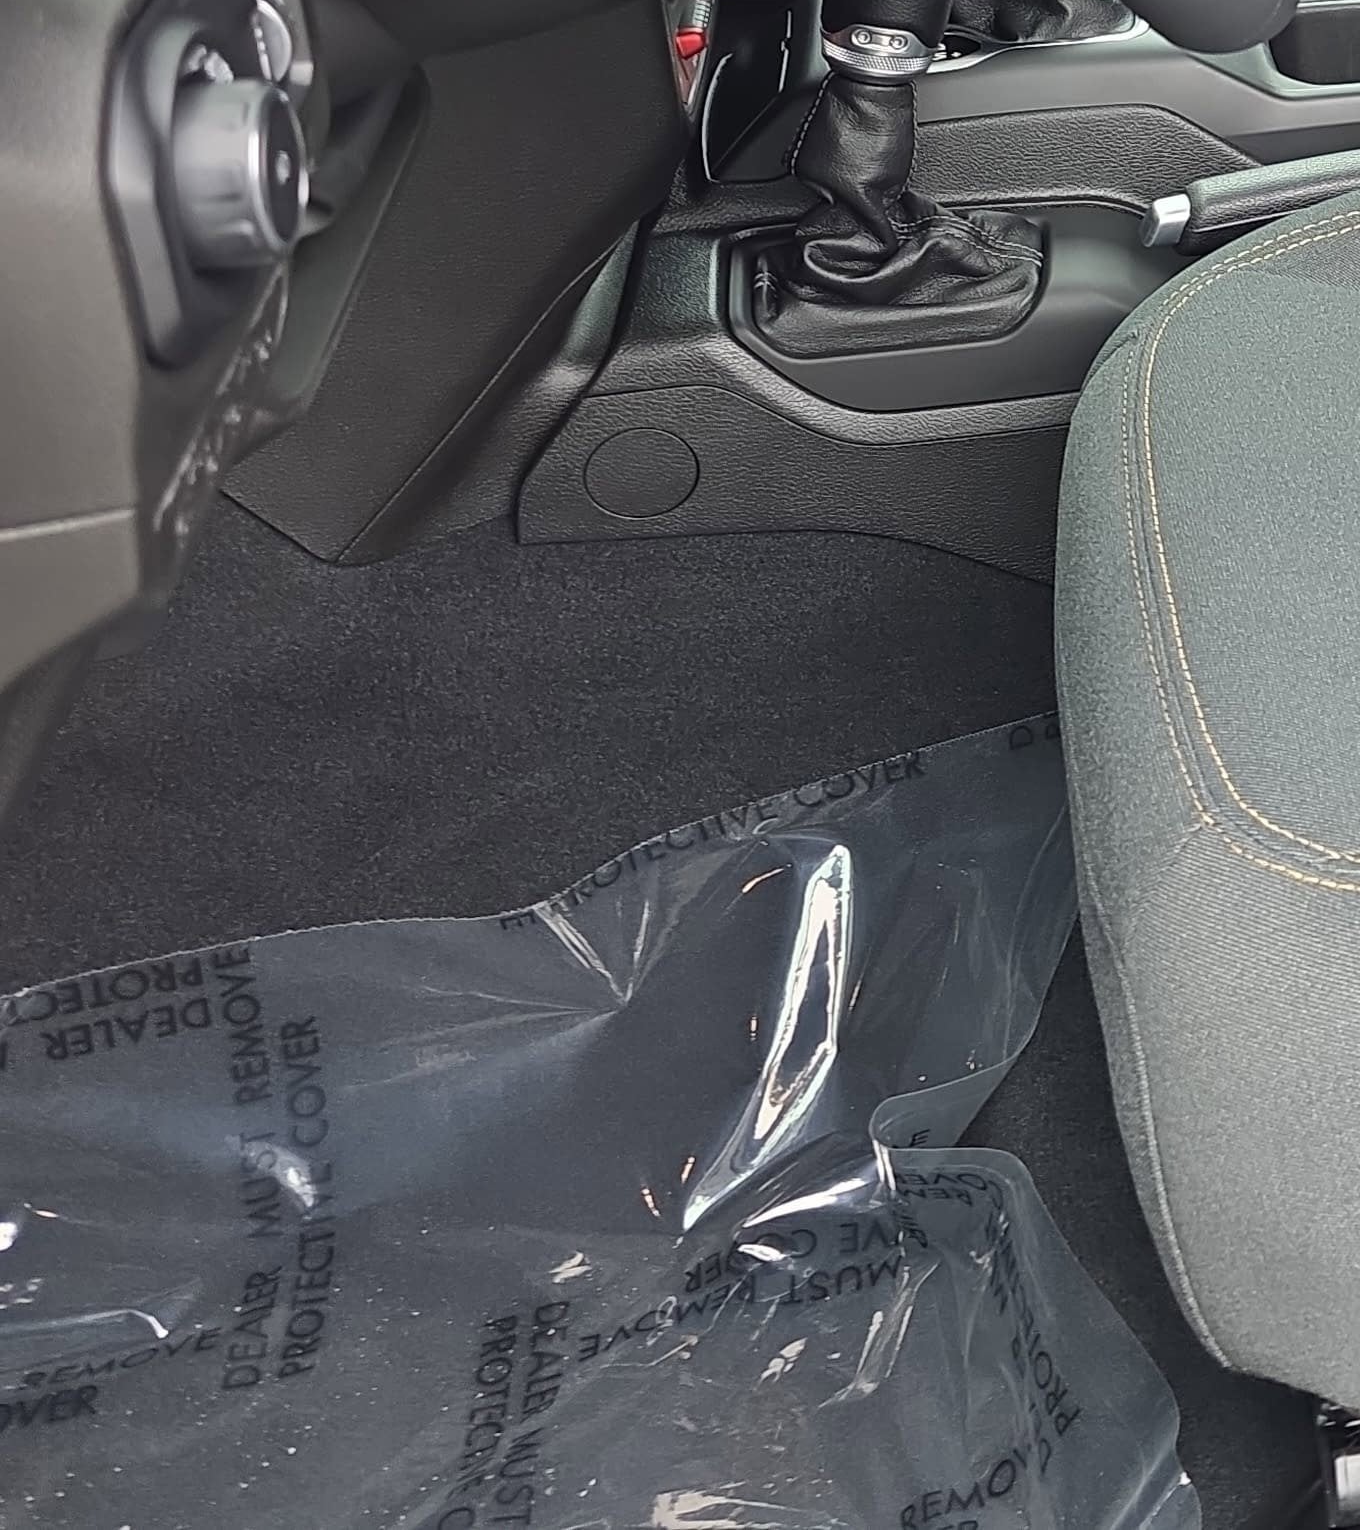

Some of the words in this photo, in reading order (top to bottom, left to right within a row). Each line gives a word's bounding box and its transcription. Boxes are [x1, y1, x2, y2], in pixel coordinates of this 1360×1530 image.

[45, 997, 212, 1062] DEALER
[211, 947, 274, 1105] REMOVE
[280, 1015, 330, 1148] COVER
[20, 1325, 223, 1391] REMOVE
[221, 1266, 283, 1389] DEALER
[520, 1301, 571, 1424] DEALER
[491, 1427, 544, 1525] MUST
